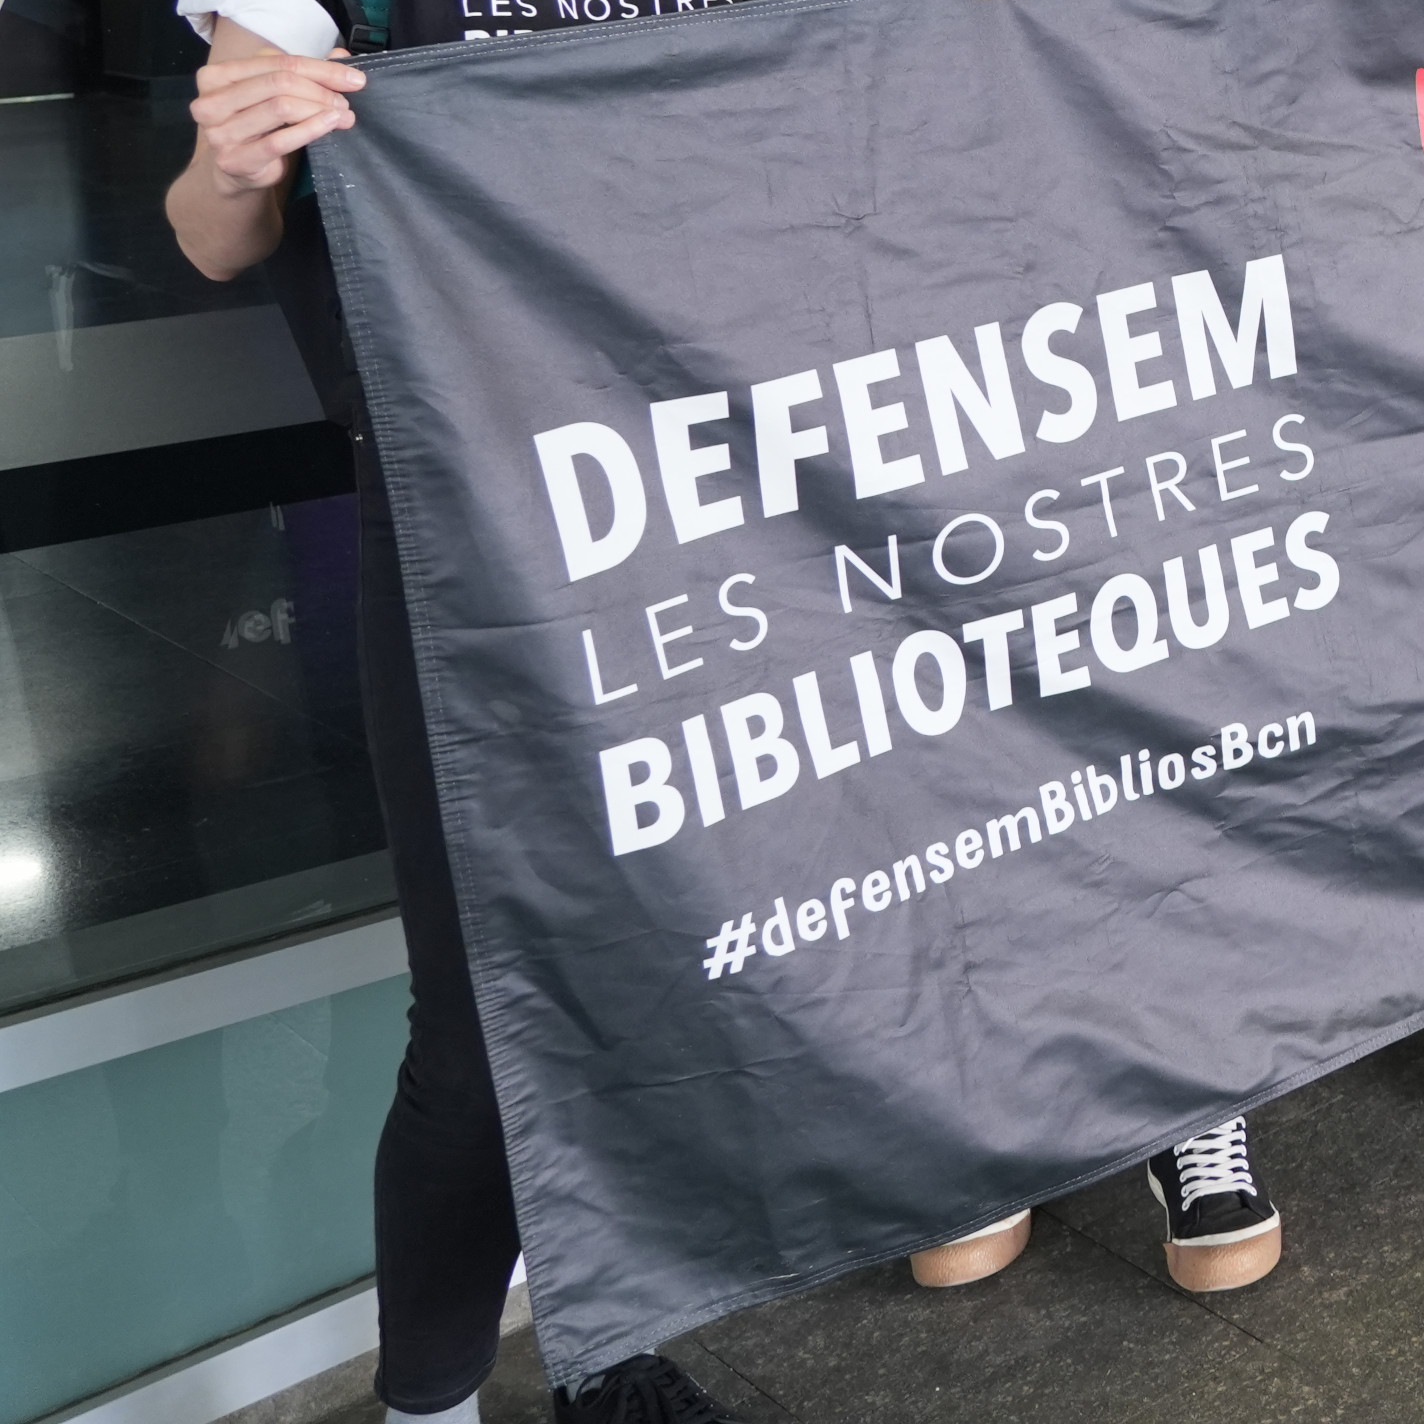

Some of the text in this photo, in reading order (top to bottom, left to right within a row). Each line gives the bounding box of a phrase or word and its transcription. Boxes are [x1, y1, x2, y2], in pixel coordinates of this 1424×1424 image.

[533, 253, 1298, 584] DEFENSEM
[581, 413, 1317, 705] LES NOSTRES
[599, 510, 1342, 857] BIBLIOTEQUES
[701, 709, 1318, 981] #defensemBibliosBcn
